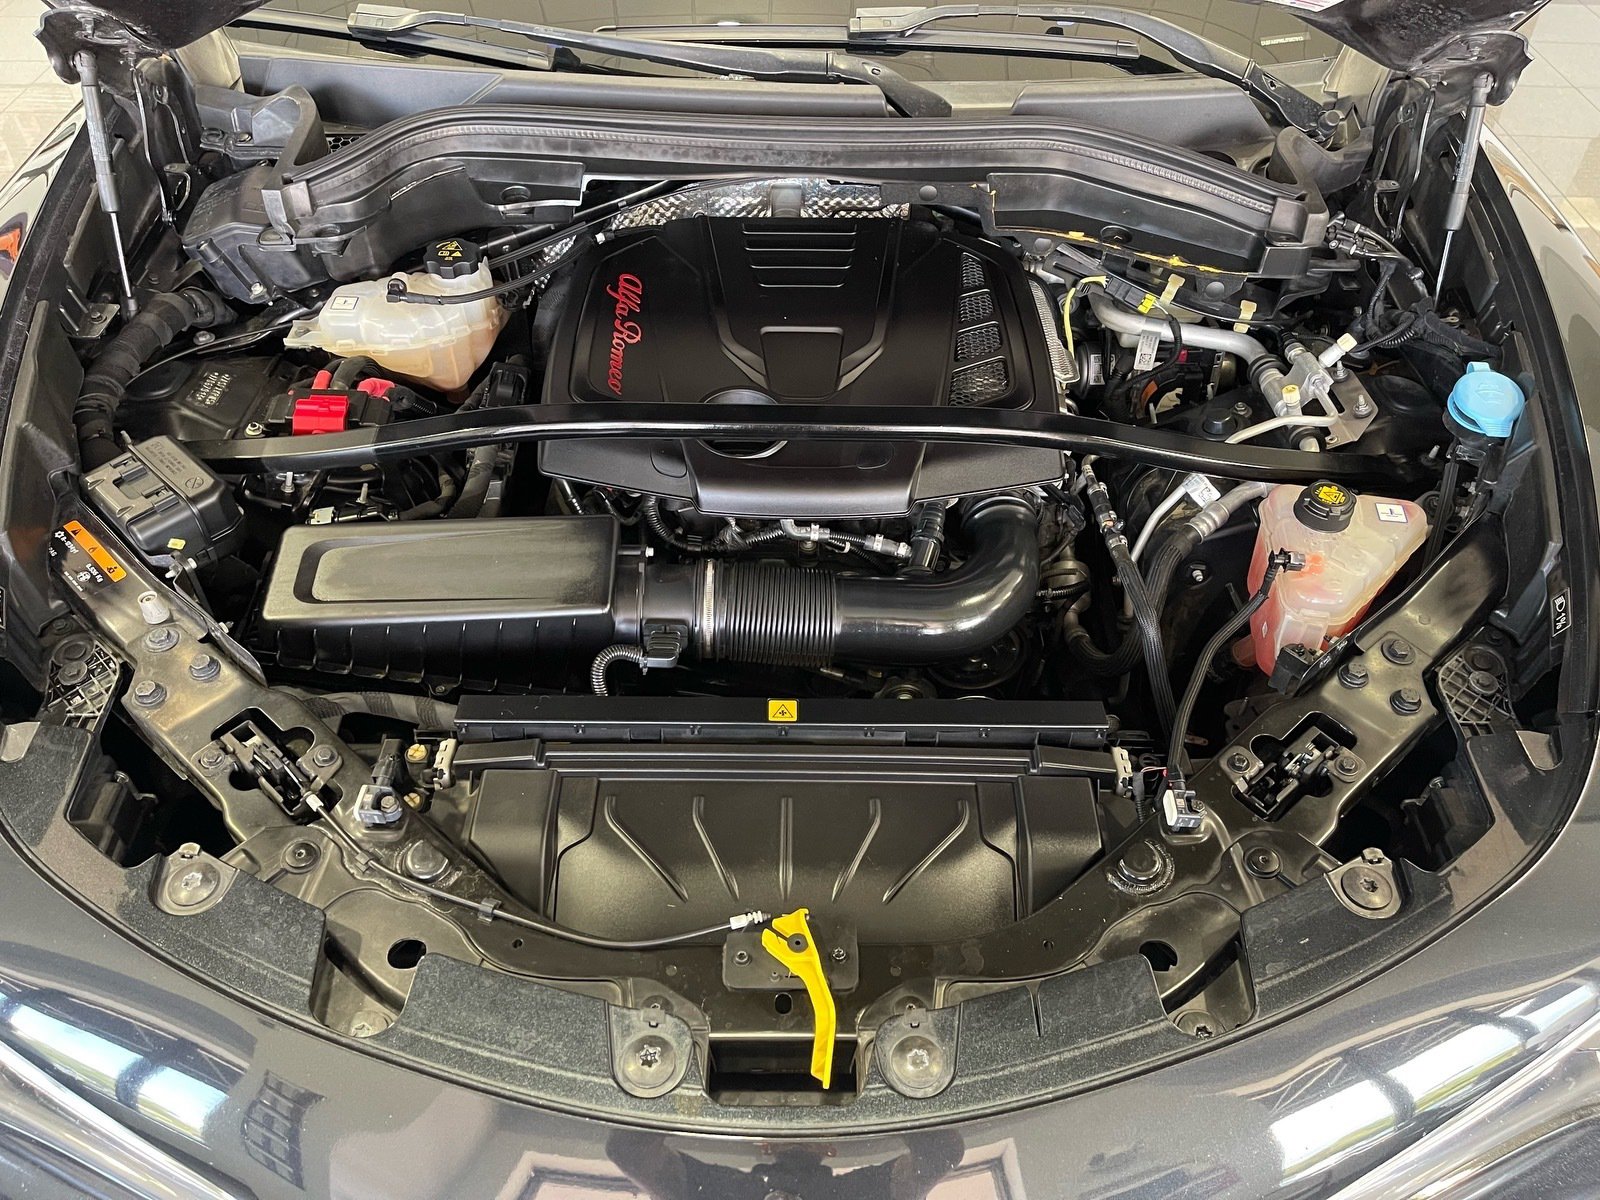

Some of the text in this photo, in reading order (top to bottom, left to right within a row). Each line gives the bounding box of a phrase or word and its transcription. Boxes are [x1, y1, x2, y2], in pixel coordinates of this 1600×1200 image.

[606, 273, 643, 395] Alfa Romeo
[1555, 612, 1567, 630] 1%
